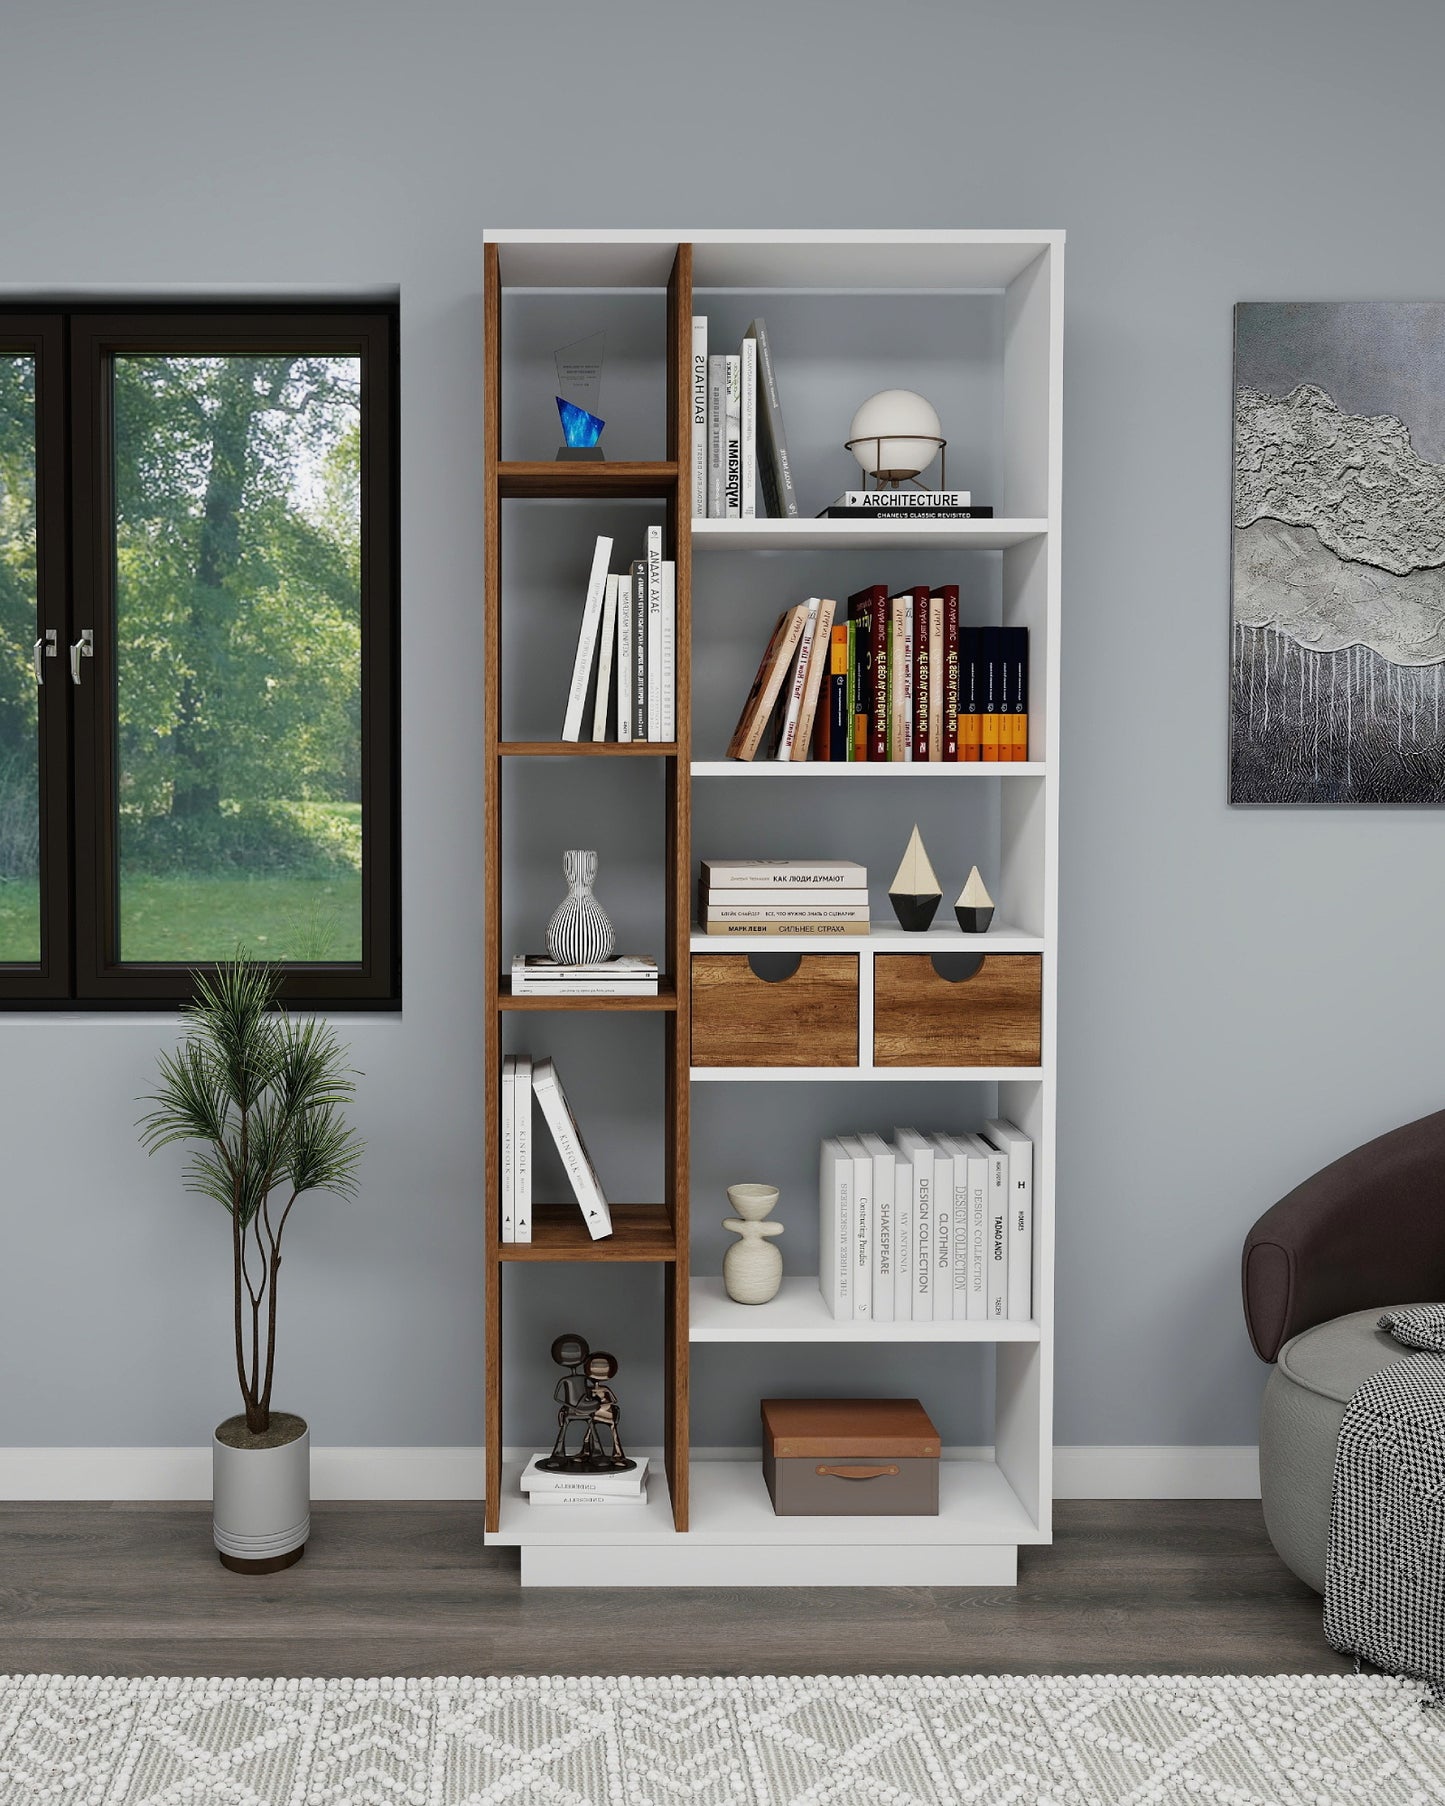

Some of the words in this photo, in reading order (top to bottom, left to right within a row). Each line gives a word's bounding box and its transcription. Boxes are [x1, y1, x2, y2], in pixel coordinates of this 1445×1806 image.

[863, 495, 958, 506] ARCHITECTURE
[789, 875, 812, 883] ЛЮДИ
[812, 875, 844, 883] ДУМАЮТ
[519, 1131, 527, 1174] KINFOLK
[559, 1134, 579, 1173] KINFOLK
[840, 1183, 848, 1244] MUSKETEERS
[858, 1197, 868, 1238] Constructing
[900, 1212, 907, 1226] MY
[919, 1178, 929, 1220] DESIGN
[955, 1186, 966, 1224] DESIGN
[974, 1189, 982, 1226] DESIGN
[880, 1203, 890, 1275] SHAKESPEARE
[938, 1213, 948, 1268] CLOTHING
[994, 1216, 1002, 1240] TADAO
[840, 1246, 848, 1276] THREE
[900, 1230, 908, 1273] ANTONIA
[919, 1223, 929, 1294] COLLECTION
[954, 1227, 966, 1290] COLLECTION
[973, 1229, 982, 1292] COLLECTION
[994, 1241, 1003, 1261] ANDO
[840, 1279, 848, 1298] THE
